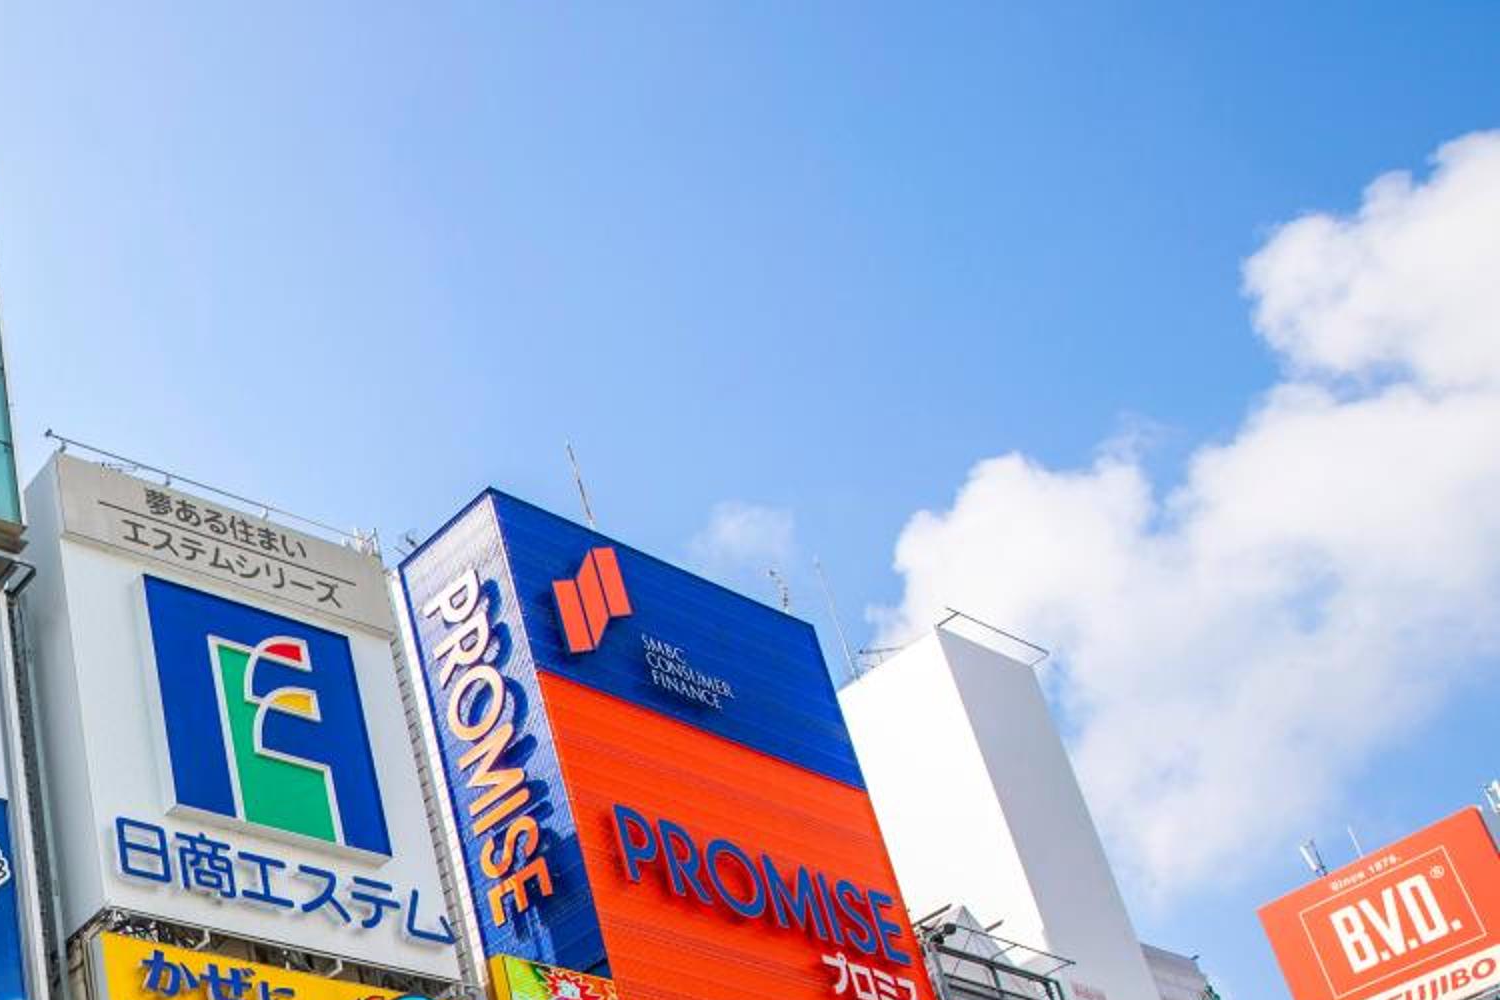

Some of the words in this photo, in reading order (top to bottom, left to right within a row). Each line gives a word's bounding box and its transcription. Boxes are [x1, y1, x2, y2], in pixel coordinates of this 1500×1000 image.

[122, 518, 342, 610] エステムシリーズ
[144, 486, 308, 560] 夢ある住まい
[641, 632, 686, 666] SMBC
[645, 651, 736, 699] CONSUMER
[651, 668, 723, 711] FINANCE
[422, 567, 555, 928] PROMISE
[115, 814, 458, 948] 日商エステム
[610, 803, 912, 965] PROMISE
[1327, 873, 1463, 975] B.V.D.
